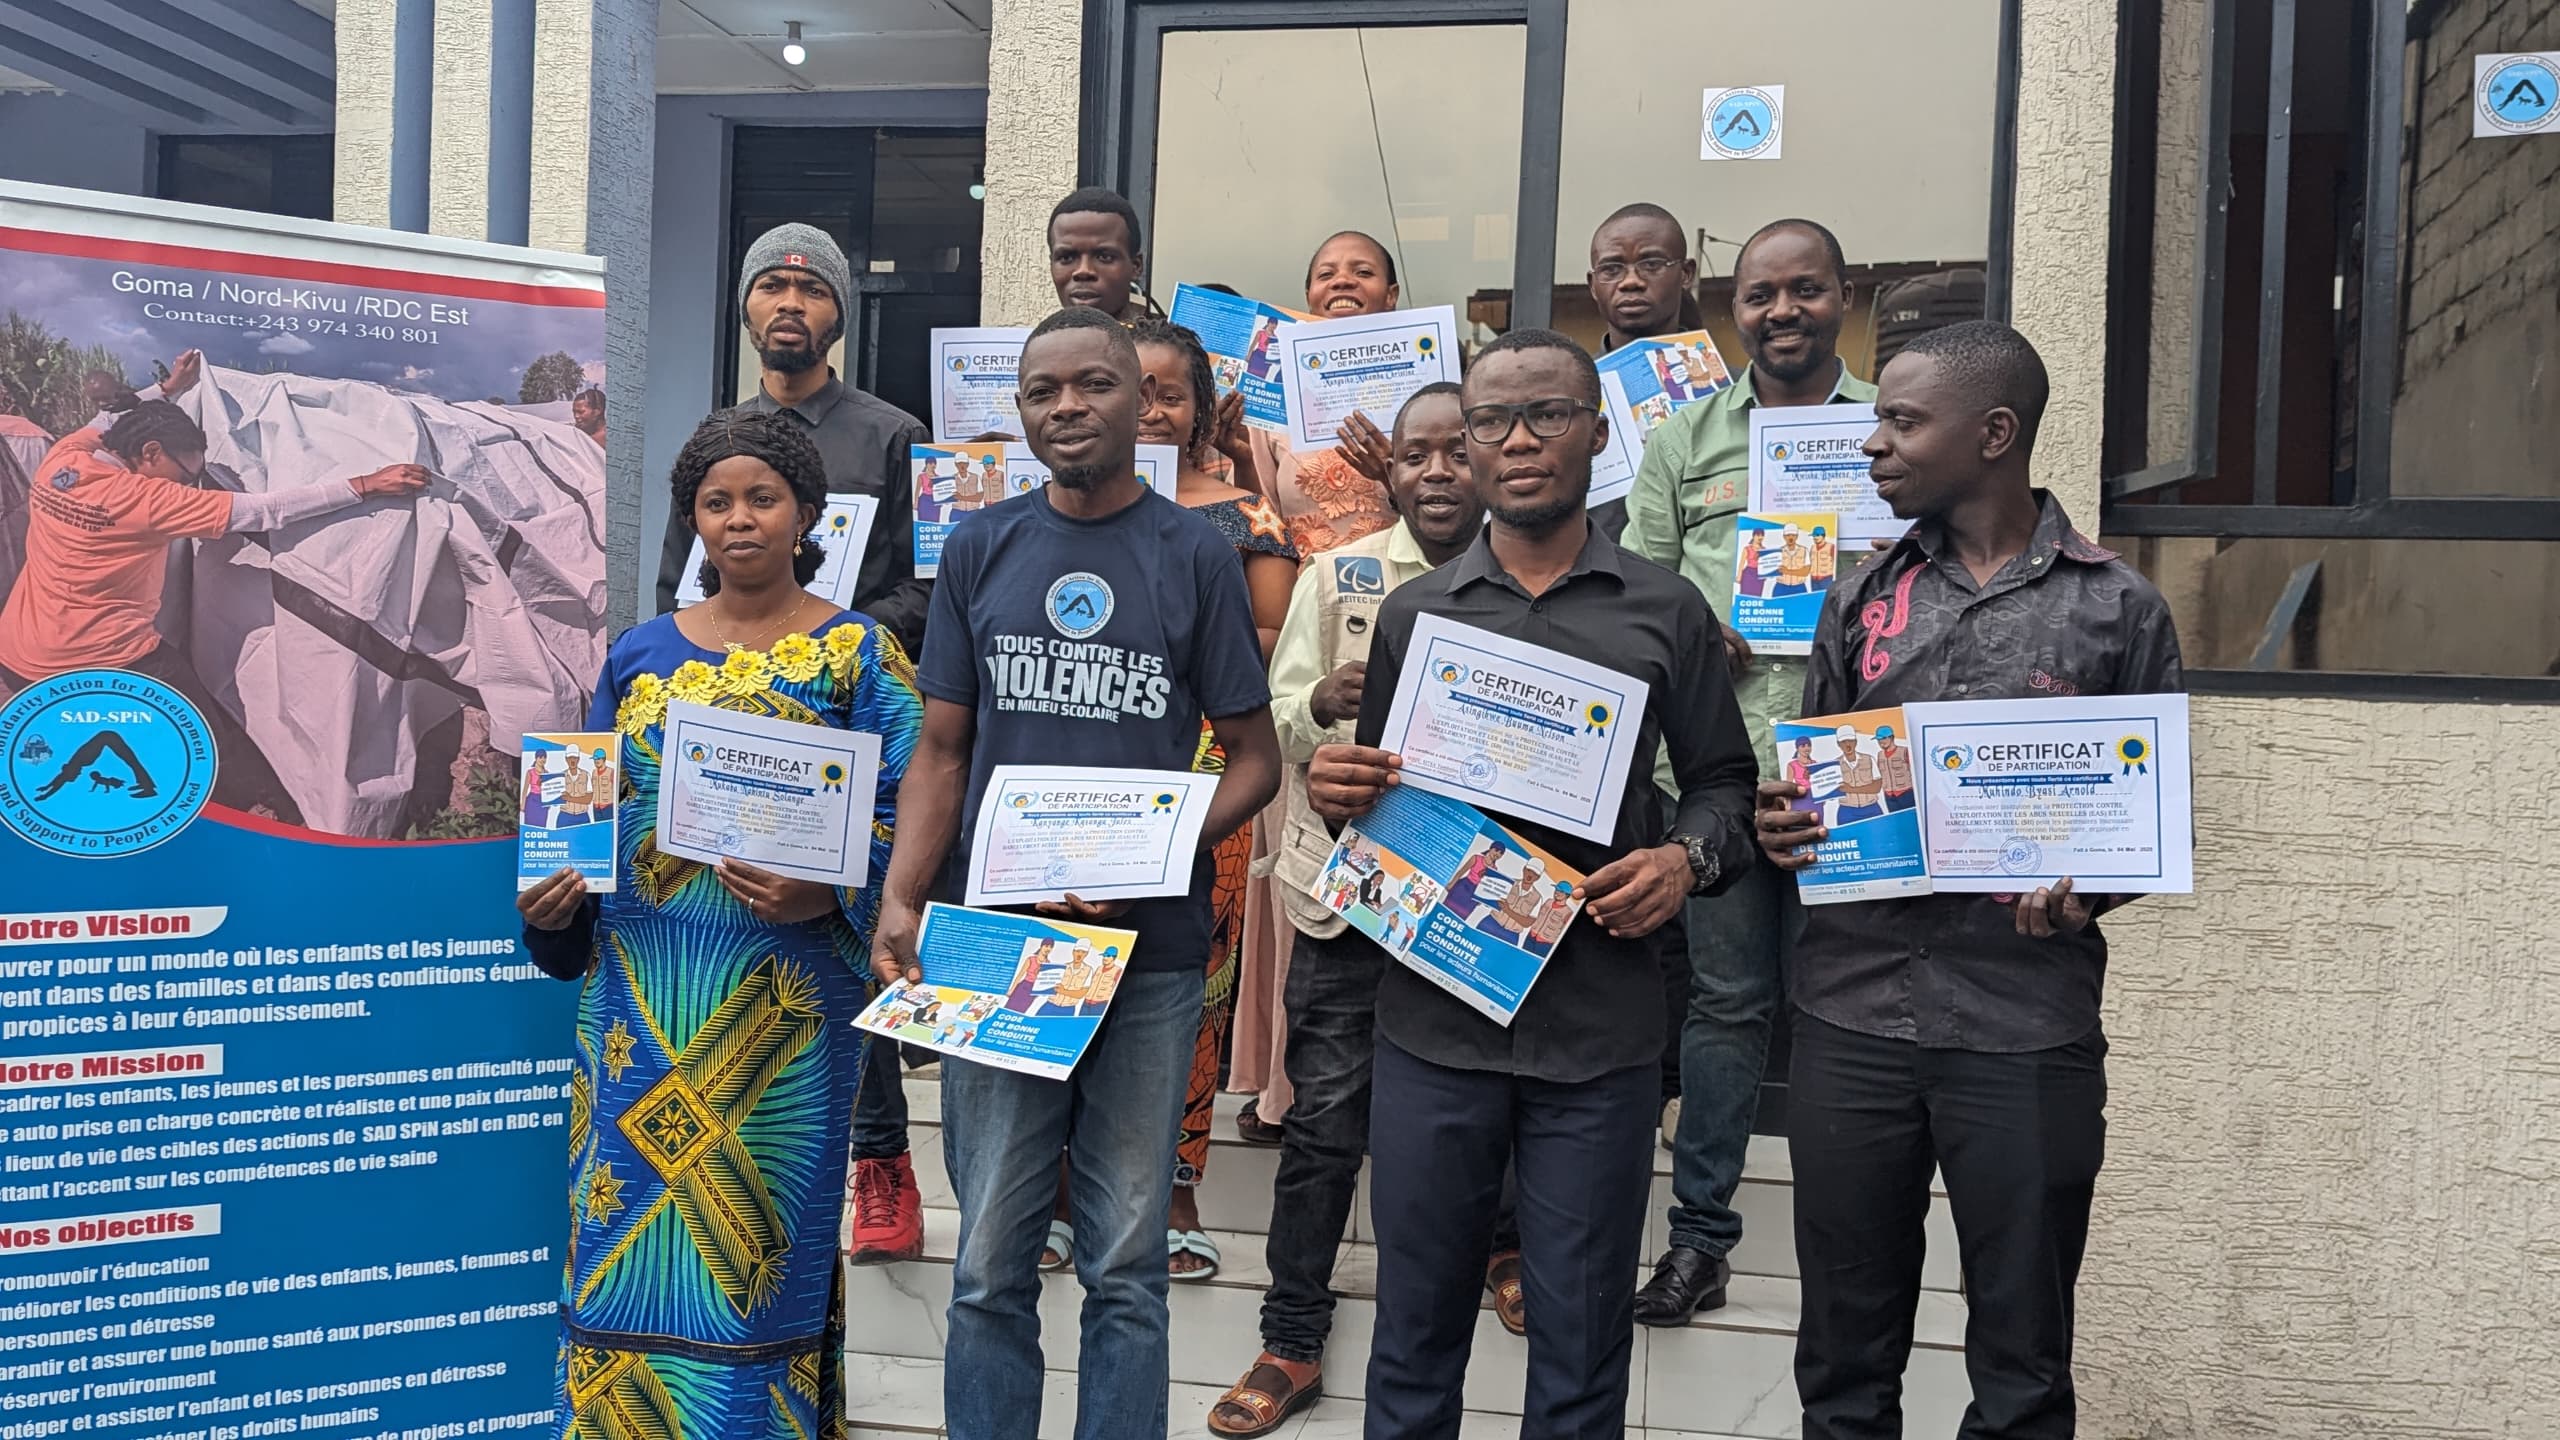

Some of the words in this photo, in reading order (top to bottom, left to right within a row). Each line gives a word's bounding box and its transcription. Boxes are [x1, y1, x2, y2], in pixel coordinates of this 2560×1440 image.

[111, 271, 194, 299] Goma
[202, 280, 211, 300] /
[221, 282, 347, 314] Nord-Kivu
[354, 294, 421, 321] /RDC
[431, 301, 469, 325] Est
[144, 303, 299, 331] Contact:+243
[307, 318, 348, 336] 974
[355, 321, 394, 340] 340
[401, 325, 440, 344] 801
[973, 355, 1019, 366] CERTIF
[1329, 341, 1409, 361] CERTIFICAT
[1348, 355, 1401, 366] PARTICIPATION
[1797, 438, 1863, 453] CERTIFIC
[1739, 600, 1764, 608] CODE
[1739, 608, 1751, 616] DE
[1753, 608, 1784, 616] BONNE
[1738, 617, 1784, 625] CONDUITE
[994, 635, 1044, 655] TOUS
[1048, 639, 1124, 666] CONTRE
[1127, 651, 1164, 675] LES
[985, 654, 1171, 719] VIOLENCES
[1471, 669, 1579, 713] CERTIFICAT
[997, 698, 1015, 711] EN
[1017, 699, 1059, 714] MILIEU
[1060, 704, 1120, 724] SCOLAIRE
[1477, 686, 1491, 698] DE
[1492, 691, 1563, 719] PARTICIPATION
[48, 678, 104, 699] Action
[110, 677, 137, 693] for
[142, 686, 208, 761] Development
[60, 710, 152, 724] SAD-SPiN
[716, 747, 813, 776] CERTIFICAT
[1977, 741, 2105, 761] CERTIFICAT
[723, 762, 734, 771] DE
[735, 764, 800, 783] PARTICIPATION
[1988, 762, 2003, 772] DE
[2006, 761, 2091, 772] PARTICIPATION
[1042, 791, 1144, 803] CERTIFICAT
[14, 808, 75, 845] Support
[81, 836, 98, 848] to
[104, 824, 160, 848] People
[161, 811, 179, 828] in
[180, 782, 202, 813] Need
[524, 831, 549, 839] CODE
[524, 841, 536, 849] DE
[538, 841, 569, 849] BONNE
[1800, 842, 1815, 853] DE
[1817, 839, 1859, 852] BONNE
[524, 850, 569, 859] CONDUITE
[1817, 850, 1862, 863] NDUITE
[1866, 858, 1919, 871] humanitaires
[86, 914, 191, 936] Vision
[1436, 912, 1465, 933] CODE
[1425, 930, 1478, 966] CONDUITE
[1431, 921, 1446, 934] DE
[1446, 930, 1482, 956] BONNE
[58, 956, 112, 977] pour
[117, 955, 146, 972] un
[151, 949, 228, 970] monde
[233, 947, 261, 966] où
[265, 946, 299, 965] les
[303, 943, 383, 964] enfants
[387, 941, 408, 960] et
[411, 940, 443, 958] les
[446, 938, 515, 959] jeunes
[46, 985, 104, 1005] dans
[109, 982, 151, 1002] des
[155, 977, 248, 999] familles
[252, 974, 274, 994] et
[278, 973, 331, 993] dans
[335, 971, 374, 991] des
[377, 965, 486, 989] conditions
[490, 962, 551, 982] équit
[3, 1015, 108, 1040] propices
[112, 1012, 127, 1031] à
[131, 1010, 178, 1031] leur
[182, 1000, 371, 1028] épanouissement.
[82, 1053, 205, 1077] Mission
[65, 1091, 96, 1109] les
[100, 1085, 177, 1107] enfants,
[181, 1083, 210, 1100] les
[213, 1079, 278, 1099] jeunes
[281, 1076, 300, 1093] et
[303, 1073, 331, 1090] les
[335, 1068, 429, 1089] personnes
[432, 1066, 453, 1081] en
[456, 1059, 532, 1080] difficulté
[536, 1057, 574, 1075] pour
[53, 1173, 132, 1198] l'accent
[135, 1173, 168, 1191] sur
[171, 1169, 200, 1187] les
[203, 1159, 330, 1184] compétences
[333, 1156, 356, 1173] de
[359, 1153, 386, 1171] vie
[389, 1150, 438, 1170] saine
[58, 1213, 194, 1244] objectifs
[102, 1256, 209, 1281] l'éducation
[102, 1323, 126, 1339] en
[130, 1314, 215, 1336] détresse
[84, 1370, 216, 1400] l'environment
